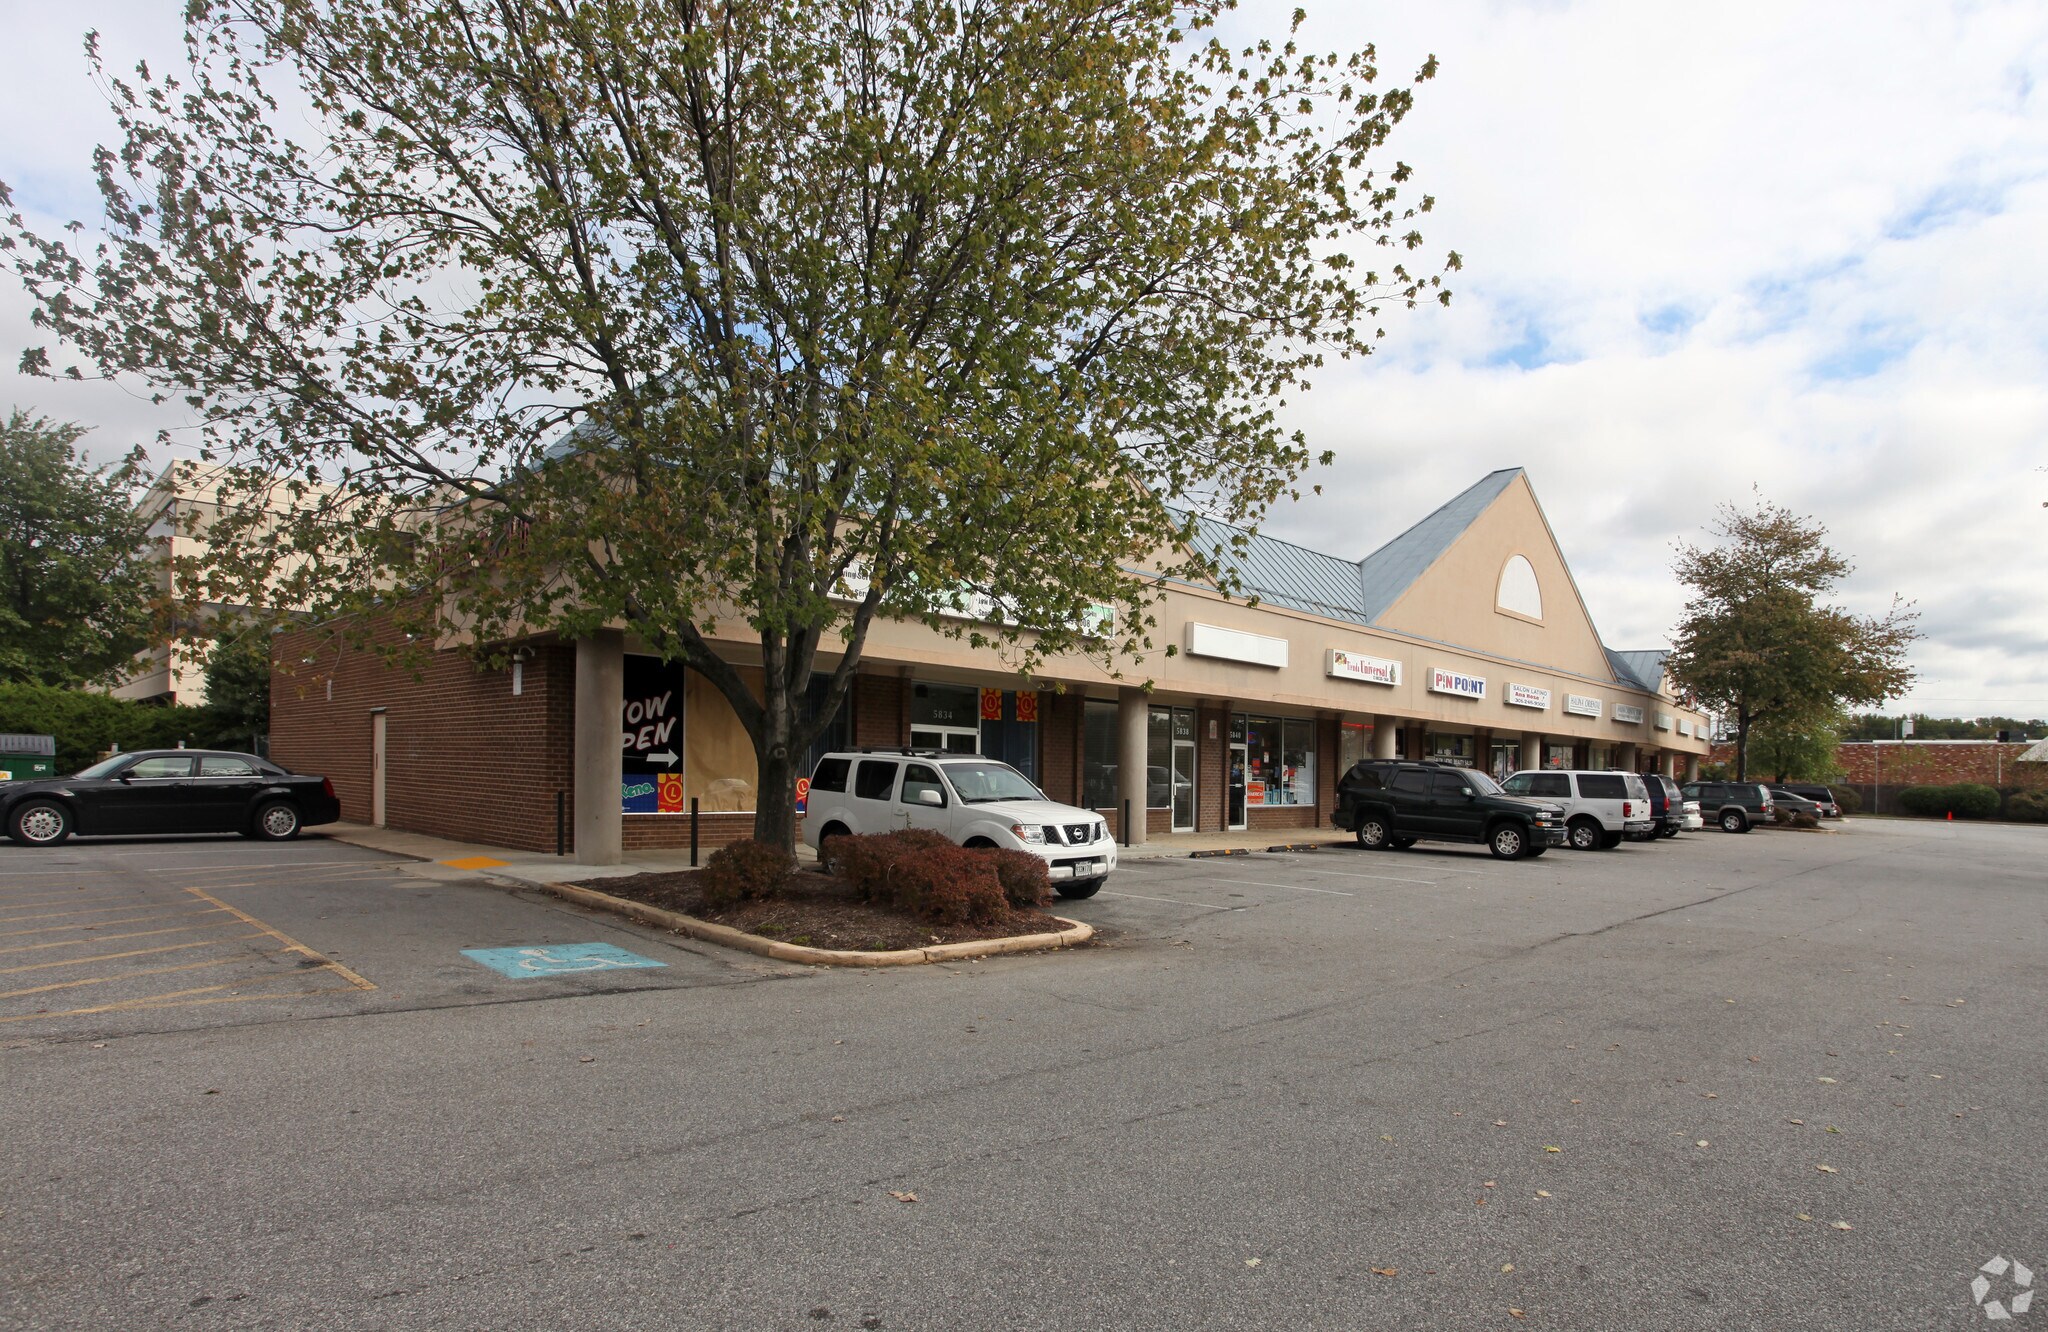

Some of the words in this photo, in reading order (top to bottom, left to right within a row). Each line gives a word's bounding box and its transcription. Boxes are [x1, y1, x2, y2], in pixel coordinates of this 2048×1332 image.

[1360, 660, 1388, 677] Universal
[1513, 685, 1530, 693] SALON
[1531, 687, 1547, 697] LATINO
[623, 690, 672, 724] OW
[933, 709, 953, 719] 5834
[623, 716, 677, 750] PEN
[1176, 727, 1190, 736] 5838
[1229, 731, 1241, 739] 5840
